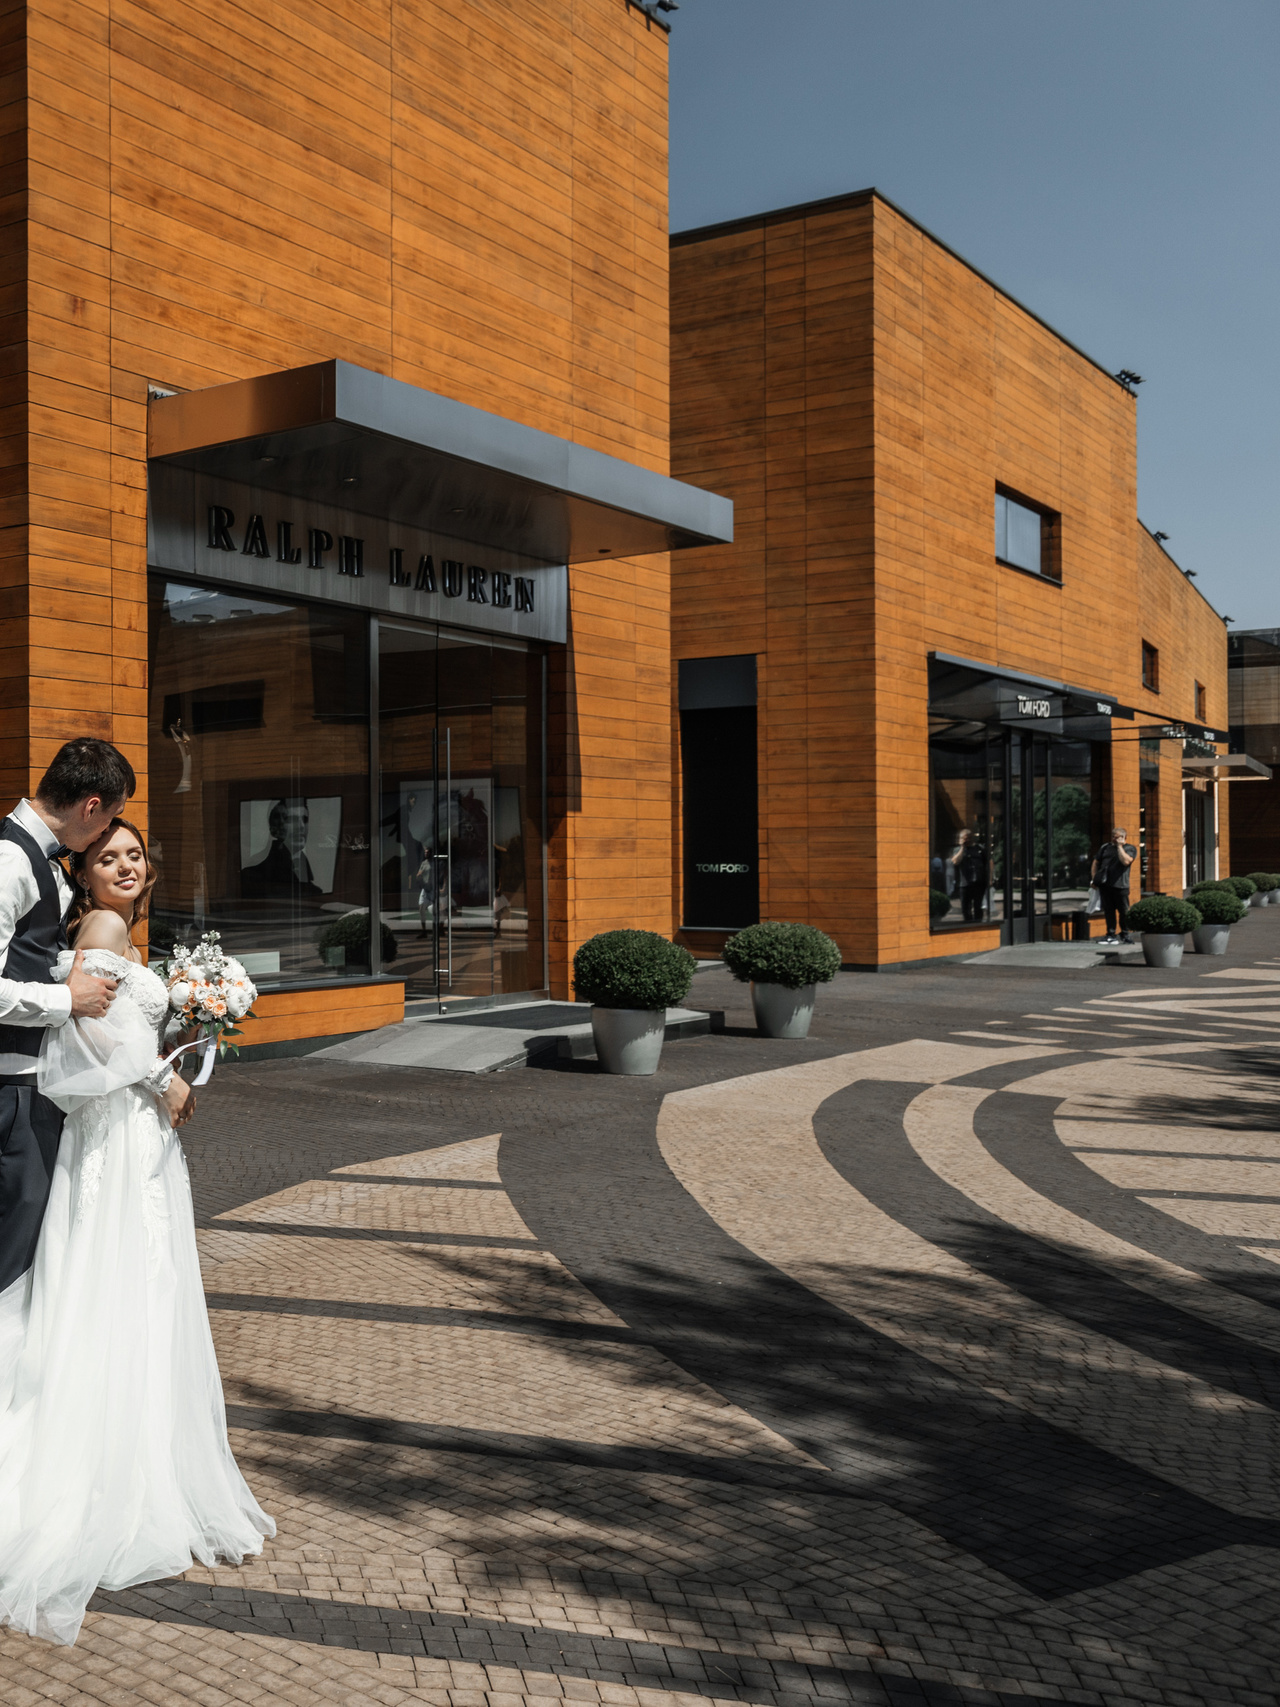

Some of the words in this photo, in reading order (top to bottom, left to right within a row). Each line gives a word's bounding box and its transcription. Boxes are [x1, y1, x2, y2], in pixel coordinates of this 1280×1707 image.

[206, 505, 365, 578] RALPH
[389, 548, 536, 613] LAUREN
[1017, 695, 1033, 715] TOM
[1032, 699, 1051, 718] FORD
[696, 863, 719, 873] TOM
[719, 863, 750, 873] FORD
